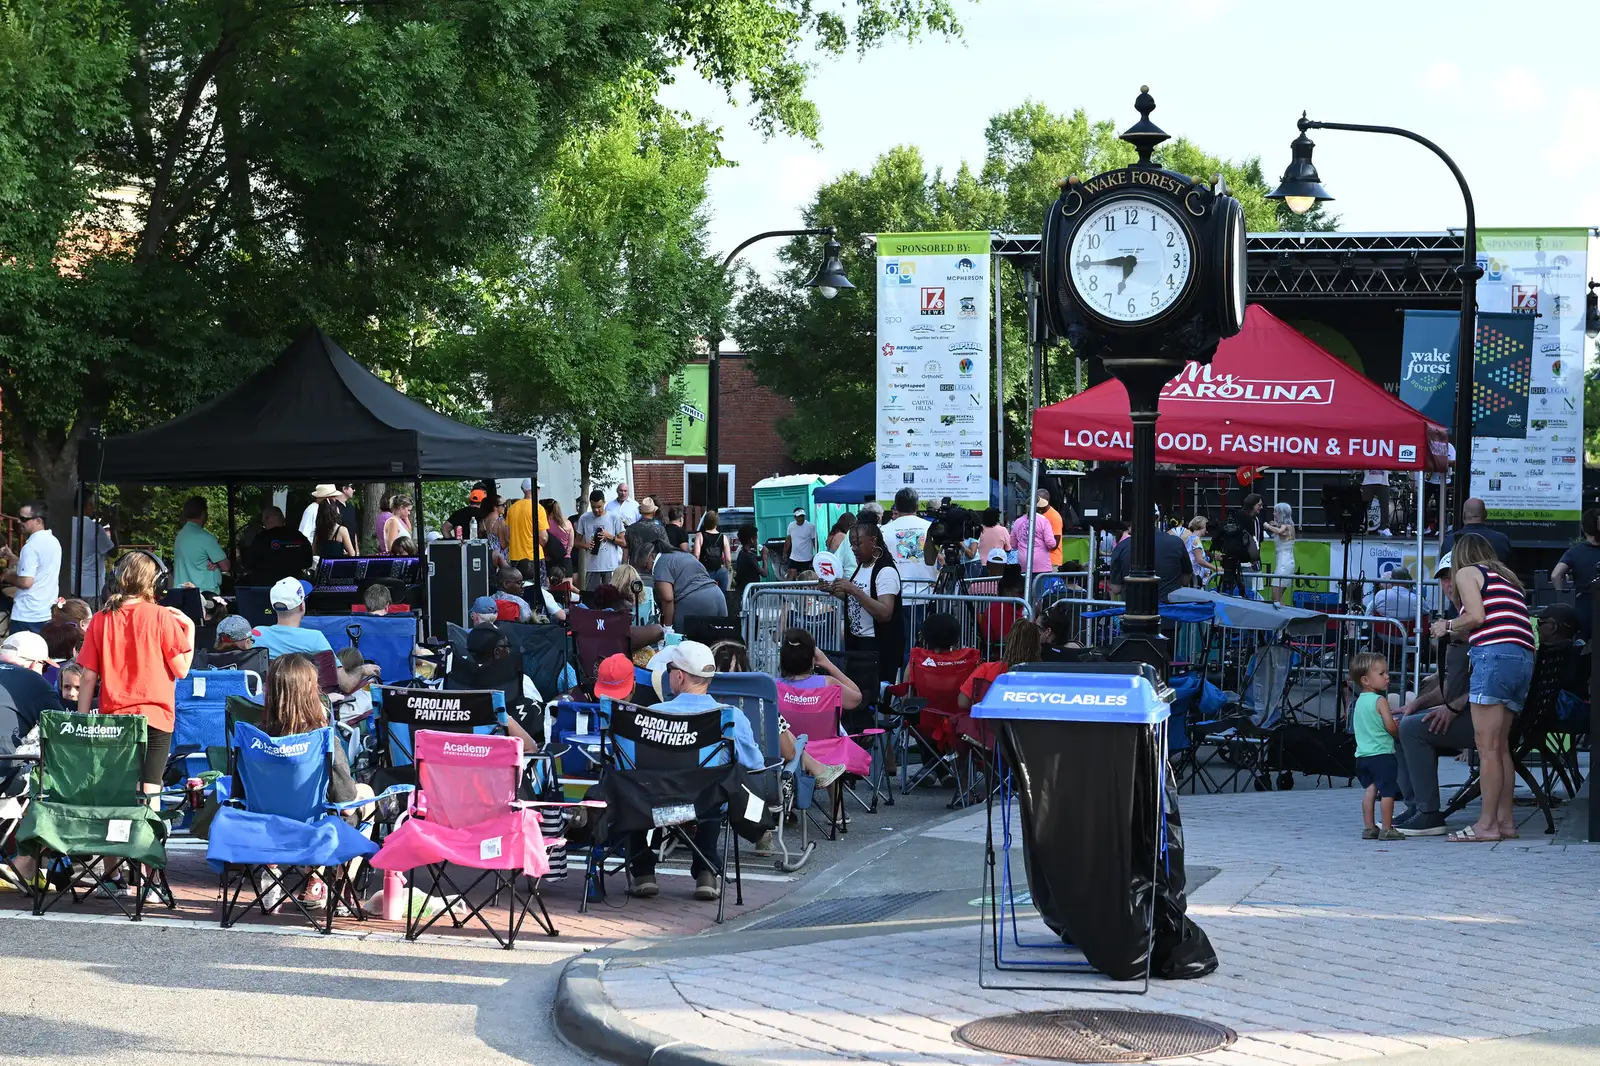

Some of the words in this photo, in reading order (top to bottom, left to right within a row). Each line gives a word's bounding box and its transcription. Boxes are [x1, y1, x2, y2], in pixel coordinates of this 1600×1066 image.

[1084, 171, 1126, 195] WAKE
[1131, 171, 1185, 196] FOREST
[1105, 216, 1115, 231] 11
[1125, 209, 1139, 225] 12
[1151, 216, 1157, 231] 1
[1087, 234, 1100, 249] 10
[1166, 232, 1175, 247] 2
[1486, 239, 1549, 248] SPONSORD
[896, 244, 954, 253] SPONSORED
[957, 243, 971, 252] BY:
[1173, 253, 1181, 268] 3
[1089, 275, 1098, 291] 8
[1166, 273, 1175, 290] 4
[1103, 293, 1112, 308] 7
[1127, 298, 1135, 314] 6
[1150, 291, 1160, 307] 5
[948, 342, 983, 352] CAPITAL
[1410, 348, 1451, 362] wake
[1175, 361, 1240, 394] My
[1403, 360, 1451, 381] forest
[1410, 379, 1447, 392] DOWNTOWN
[684, 405, 704, 420] WHITE
[1064, 429, 1134, 449] LOCAL
[1157, 432, 1213, 454] OOD,
[1220, 434, 1323, 455] FASHION
[1325, 438, 1341, 455] &
[1348, 438, 1394, 457] FUN
[407, 697, 461, 710] CAROLINA
[783, 692, 819, 704] Academy
[1003, 691, 1128, 706] RECYCLABLES
[415, 709, 471, 721] PANTHERS
[75, 724, 122, 736] Academy
[634, 713, 688, 733] CAROLINA
[641, 728, 699, 746] PANTHERS
[263, 742, 309, 754] Academy
[443, 741, 491, 757] Academy
